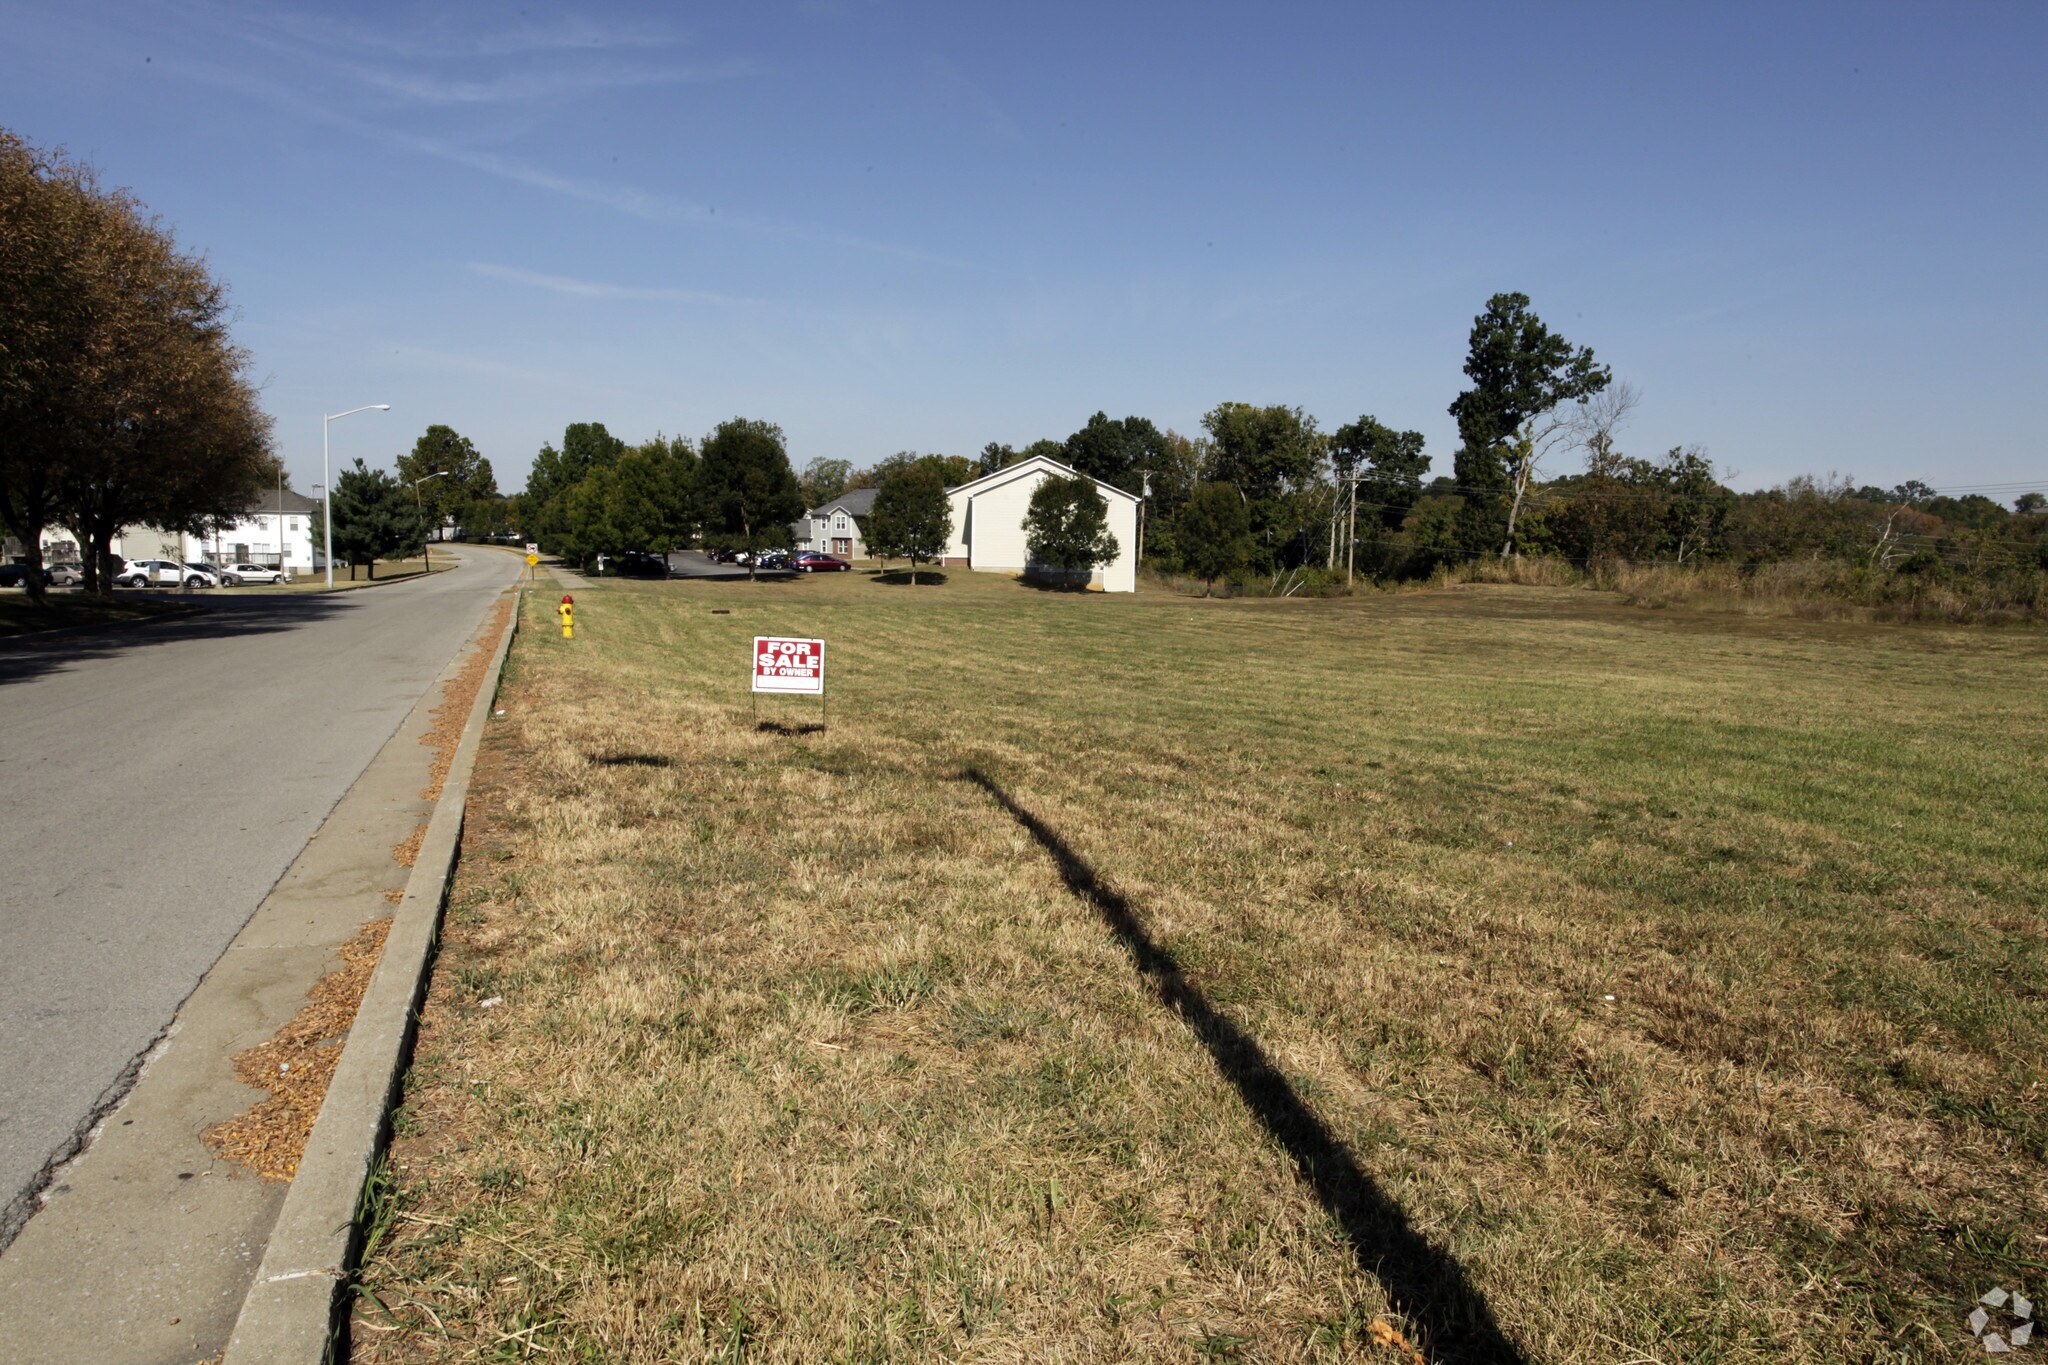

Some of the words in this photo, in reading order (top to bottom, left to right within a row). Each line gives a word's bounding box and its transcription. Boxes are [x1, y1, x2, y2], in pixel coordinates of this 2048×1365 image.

[767, 642, 811, 655] FOR
[758, 653, 819, 669] SALE
[763, 667, 777, 676] BY
[779, 668, 813, 677] OWNER
